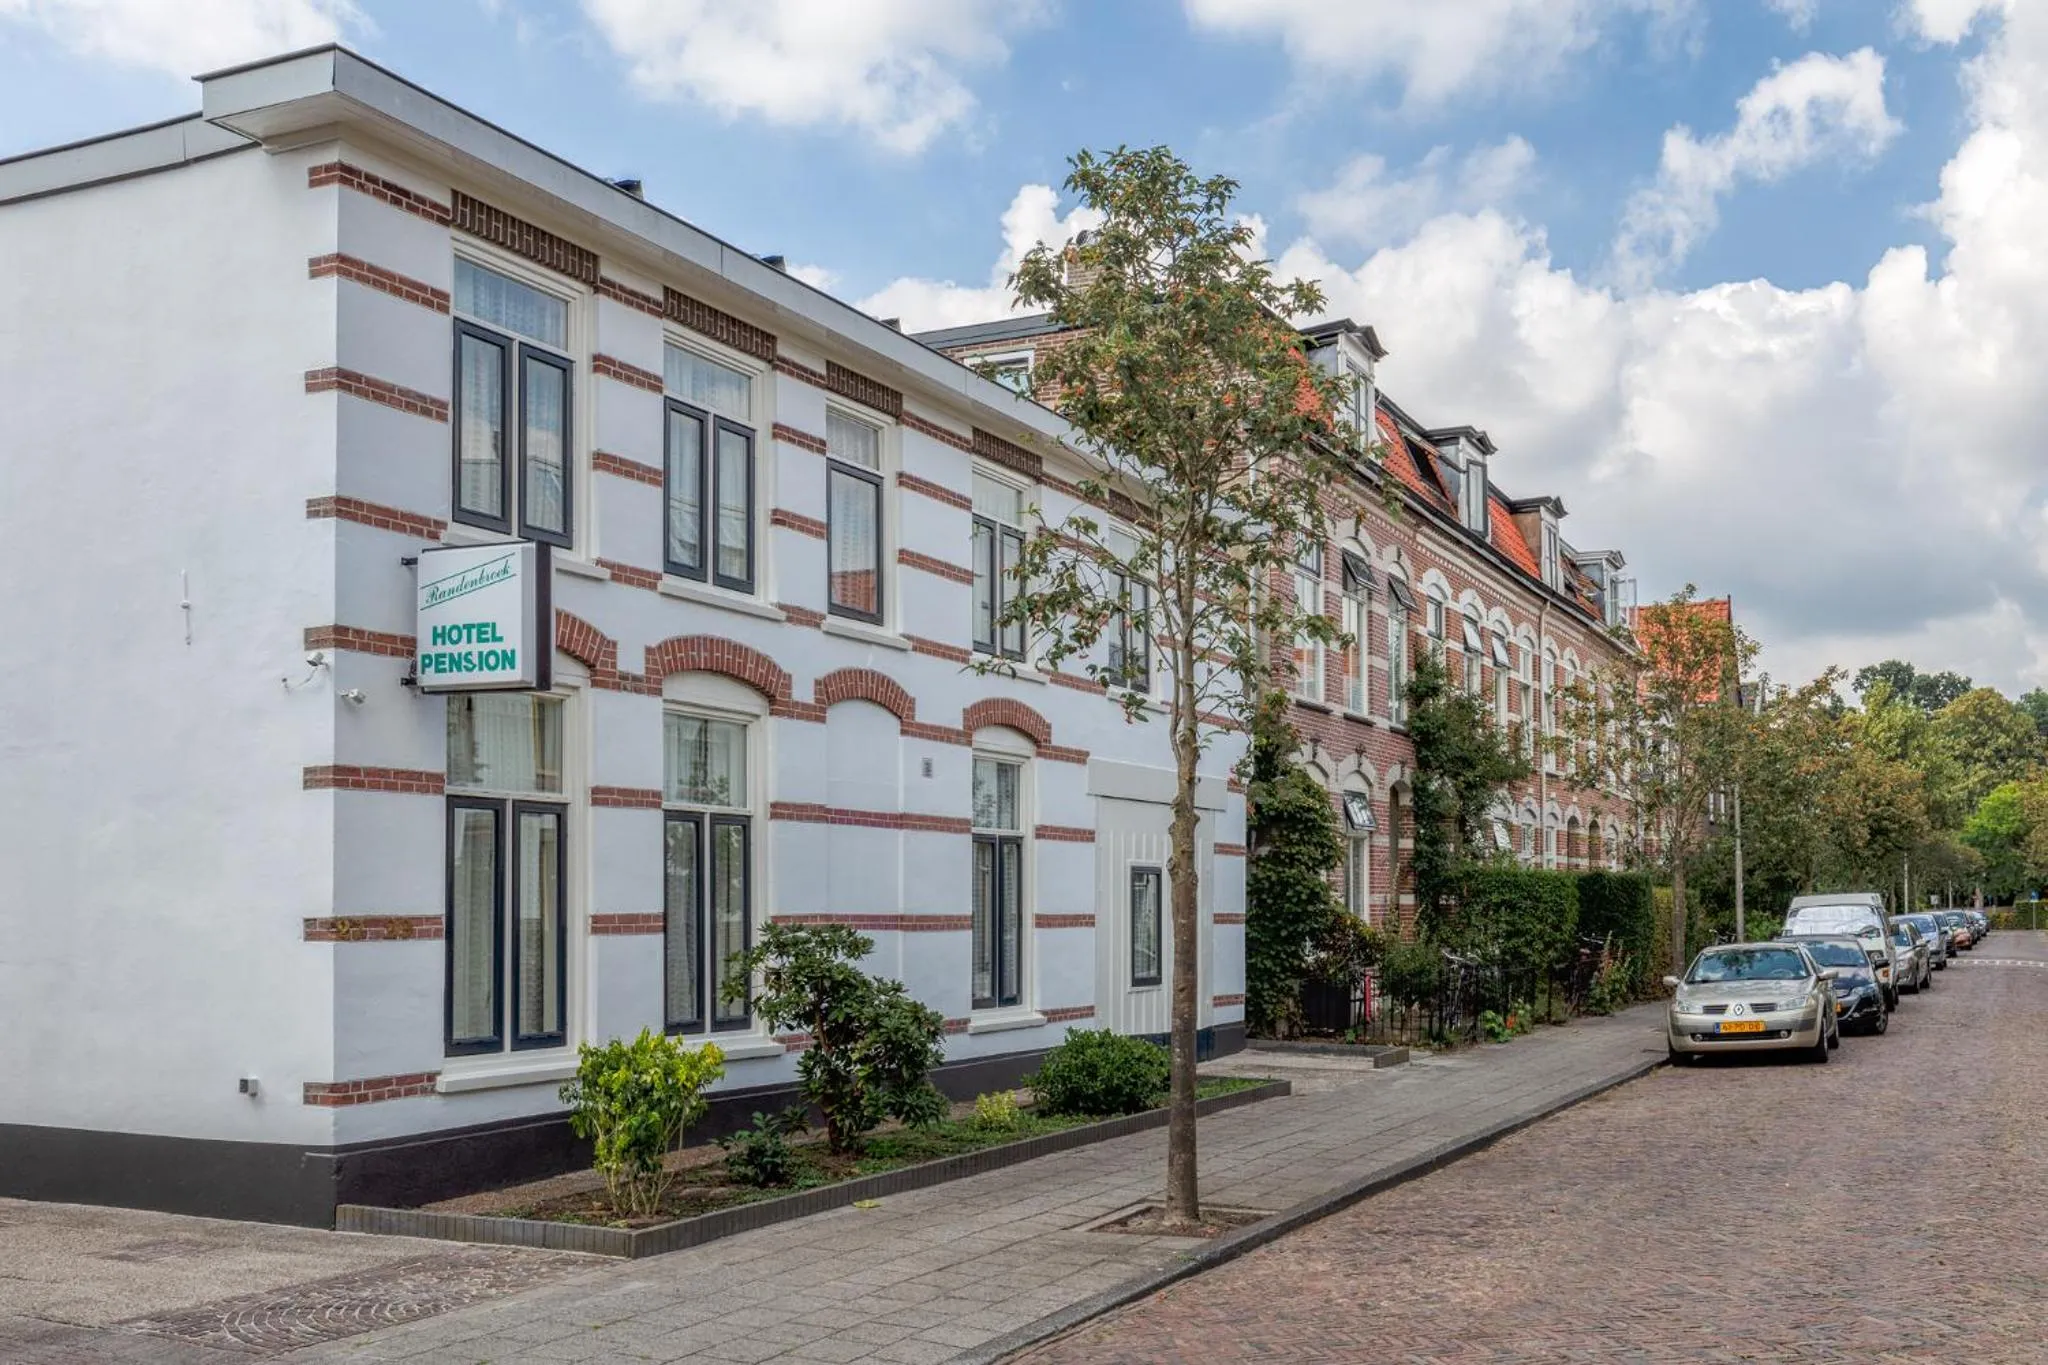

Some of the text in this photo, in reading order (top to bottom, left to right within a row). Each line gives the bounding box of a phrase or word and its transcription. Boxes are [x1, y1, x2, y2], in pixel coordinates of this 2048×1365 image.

[425, 559, 511, 603] Randenbroek
[432, 622, 504, 646] HOTEL
[420, 648, 516, 674] PENSION
